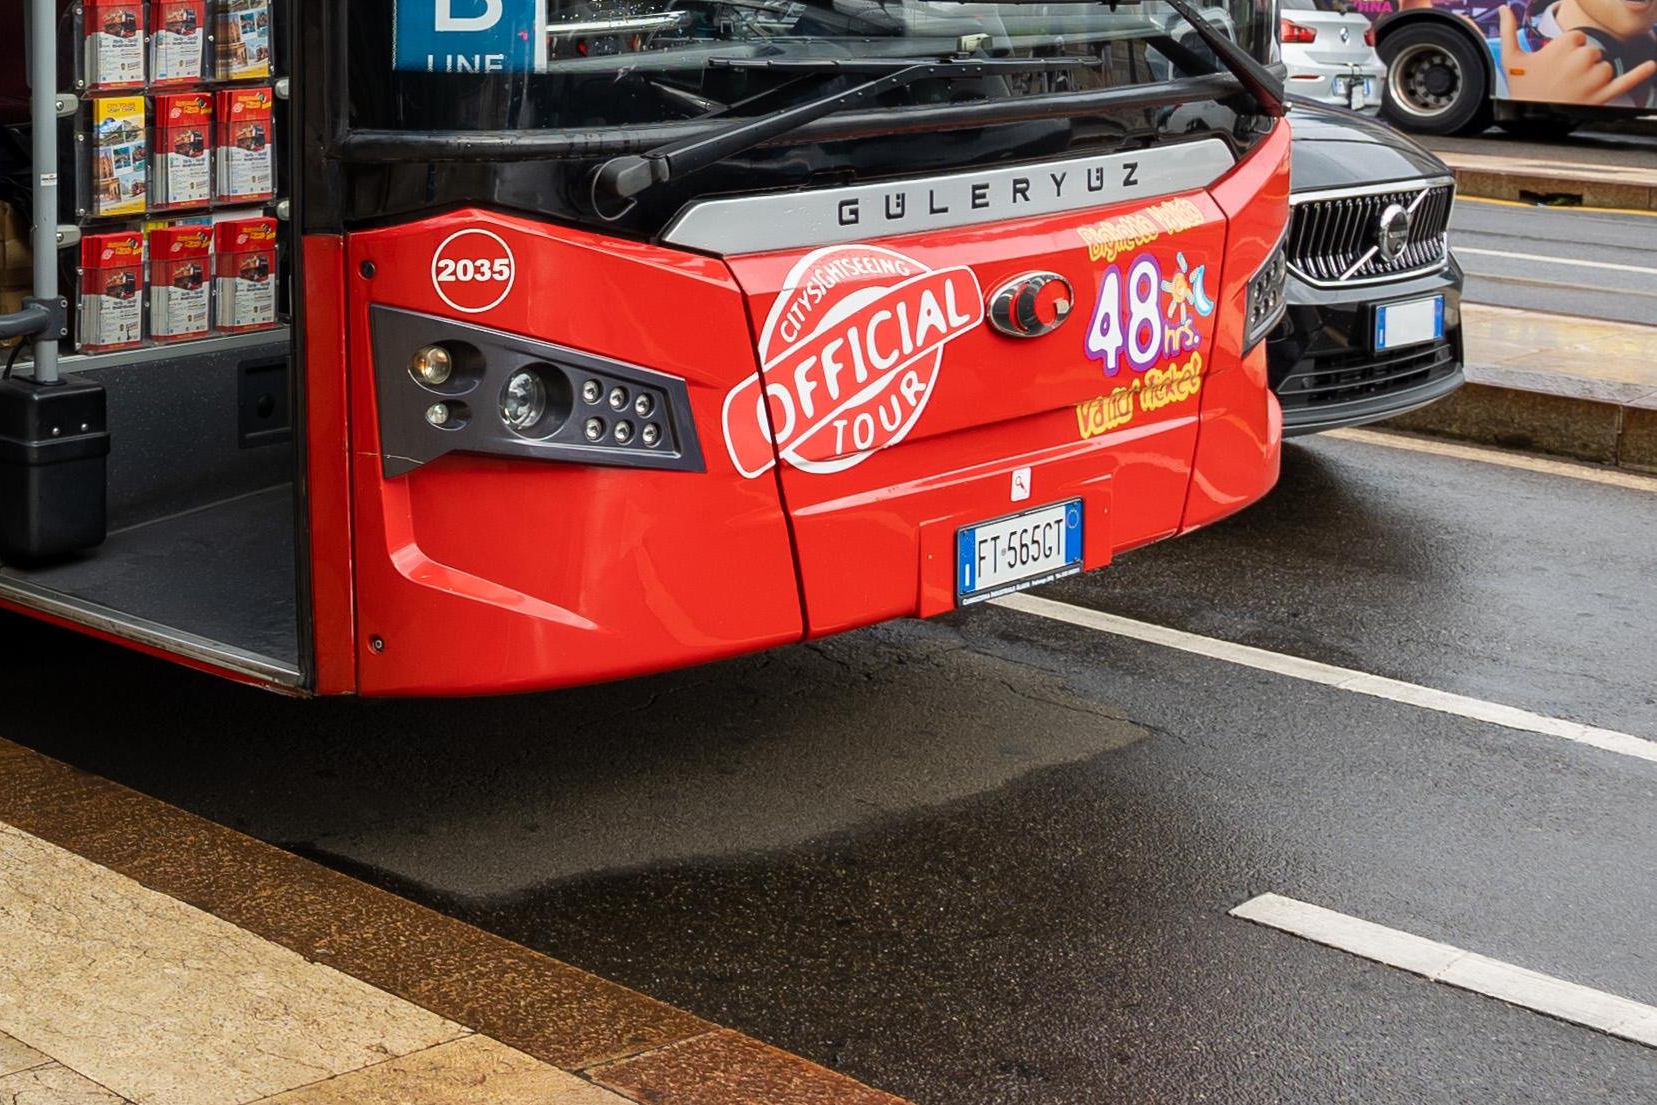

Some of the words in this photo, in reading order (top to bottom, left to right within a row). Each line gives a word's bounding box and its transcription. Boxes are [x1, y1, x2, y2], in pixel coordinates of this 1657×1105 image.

[838, 162, 1139, 226] GÜLERYÜZ
[437, 258, 510, 282] 2035
[780, 256, 910, 343] CITYSIGHTSEEING
[1085, 254, 1162, 376] 48
[756, 278, 971, 444] OFFICIAL
[833, 370, 926, 455] TOUR
